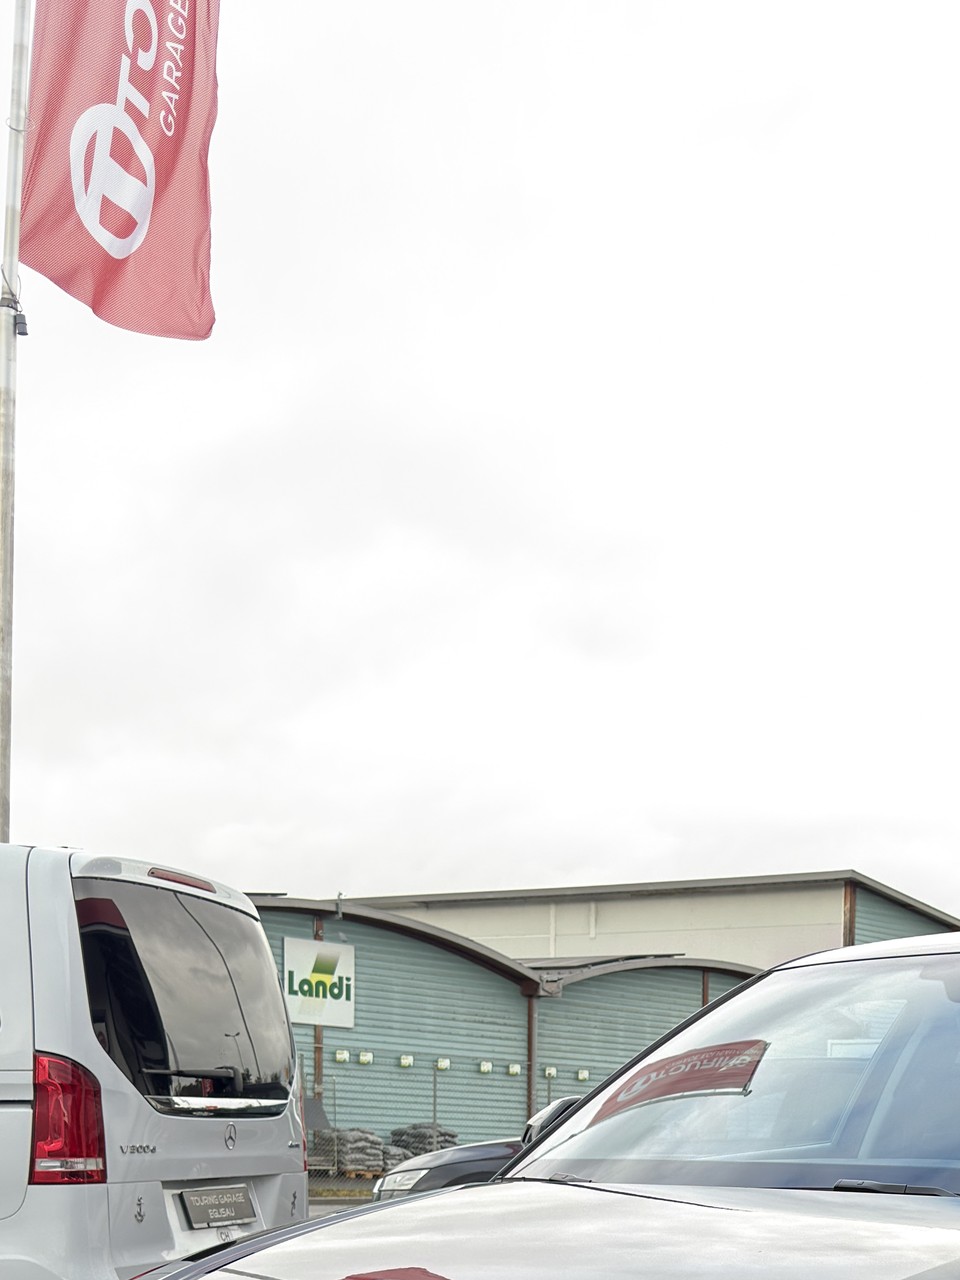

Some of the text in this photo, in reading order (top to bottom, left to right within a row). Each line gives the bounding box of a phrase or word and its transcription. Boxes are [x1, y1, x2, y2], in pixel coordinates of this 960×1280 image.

[160, 0, 189, 137] GARAGE
[288, 970, 351, 1001] Landi
[190, 1193, 245, 1206] TOURING GARAGE
[209, 1207, 235, 1218] EGLISAU
[220, 1231, 231, 1242] CH
